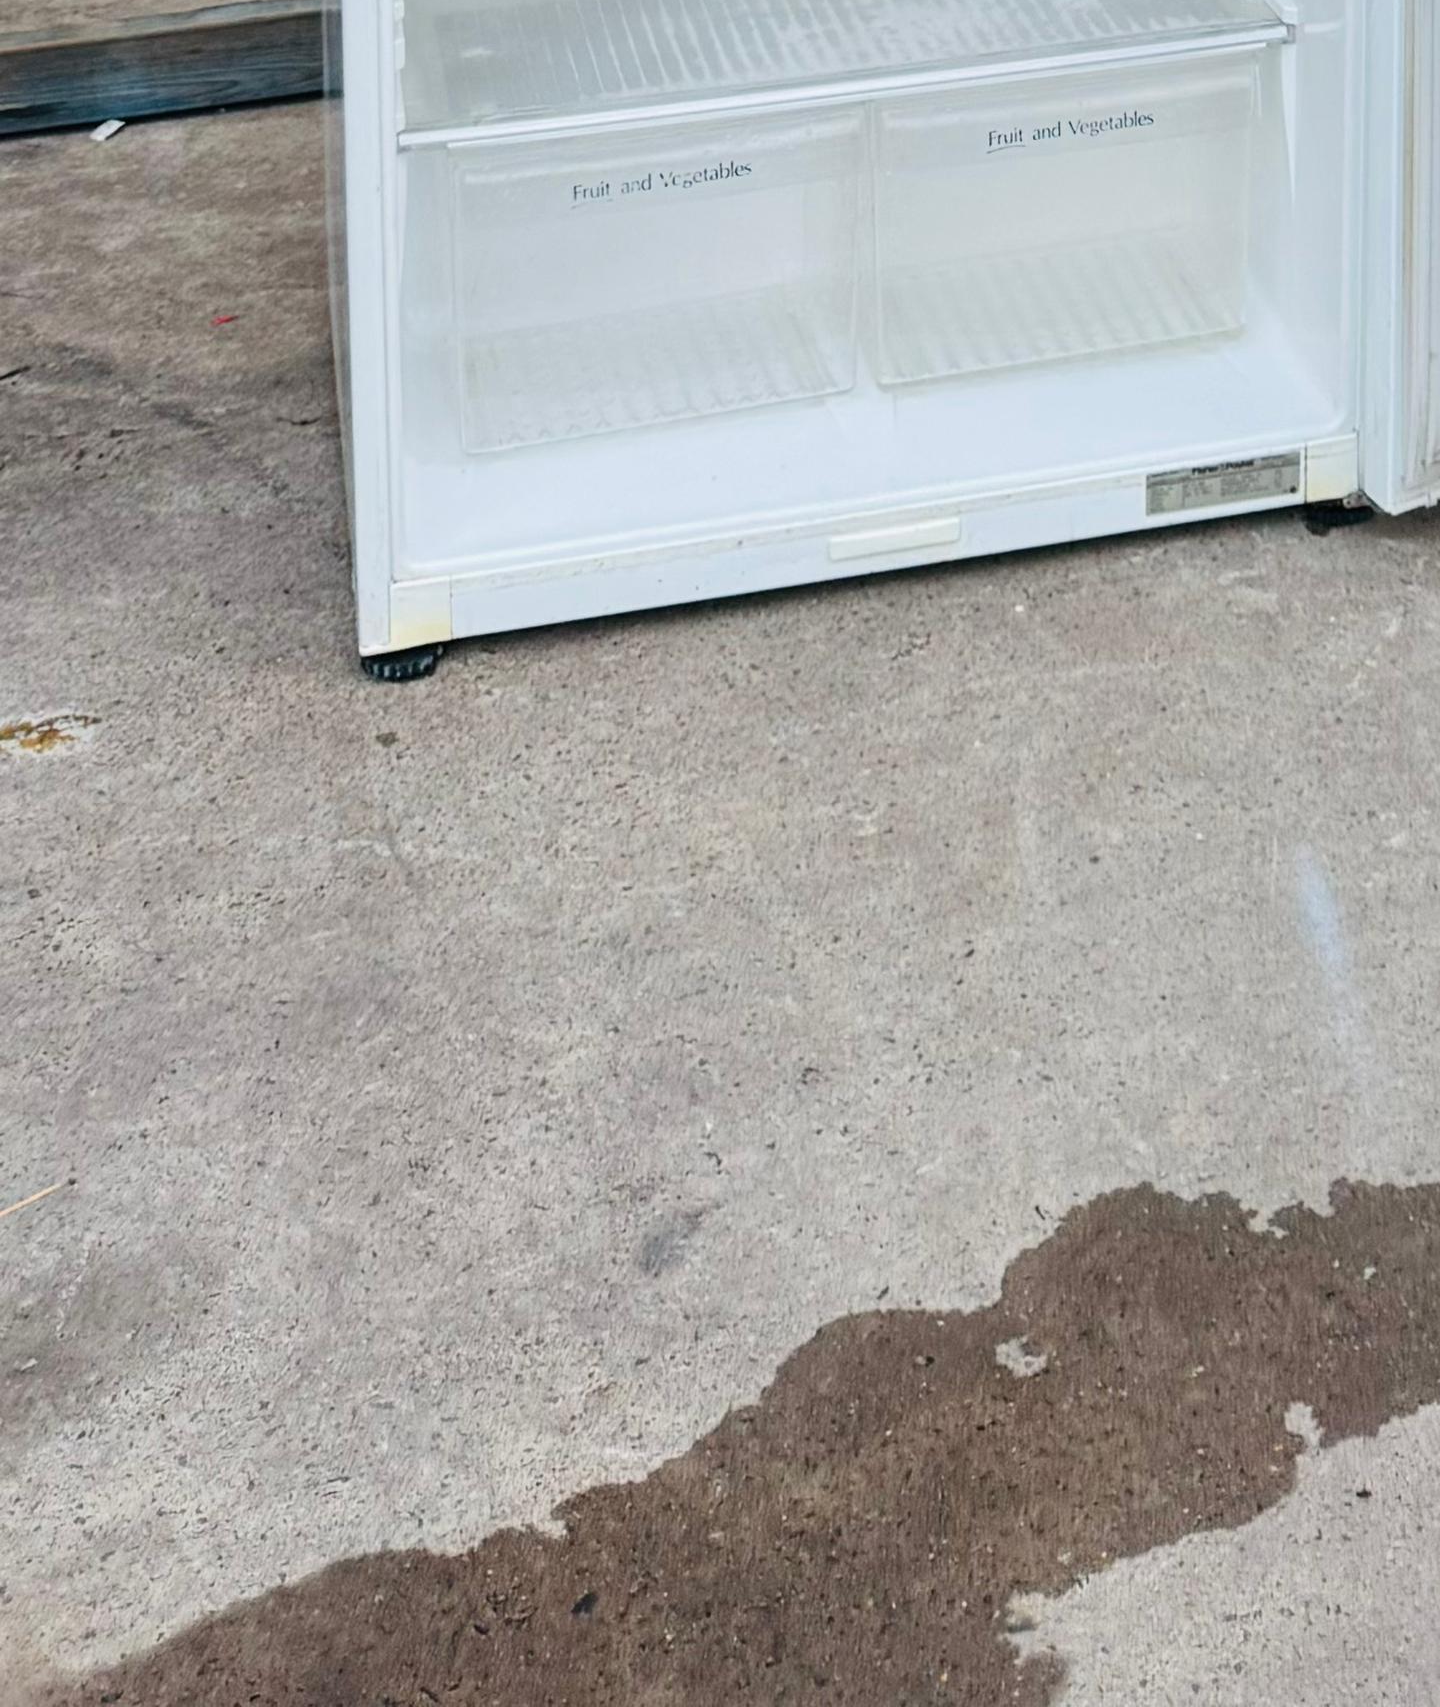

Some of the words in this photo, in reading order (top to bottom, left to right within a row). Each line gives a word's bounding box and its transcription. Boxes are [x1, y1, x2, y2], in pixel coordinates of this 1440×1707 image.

[988, 127, 1024, 148] Fruit
[1032, 121, 1062, 141] and
[1068, 111, 1154, 136] Vegetables
[573, 181, 611, 201] Fruit
[621, 173, 652, 194] and
[660, 160, 752, 188] Vegetables
